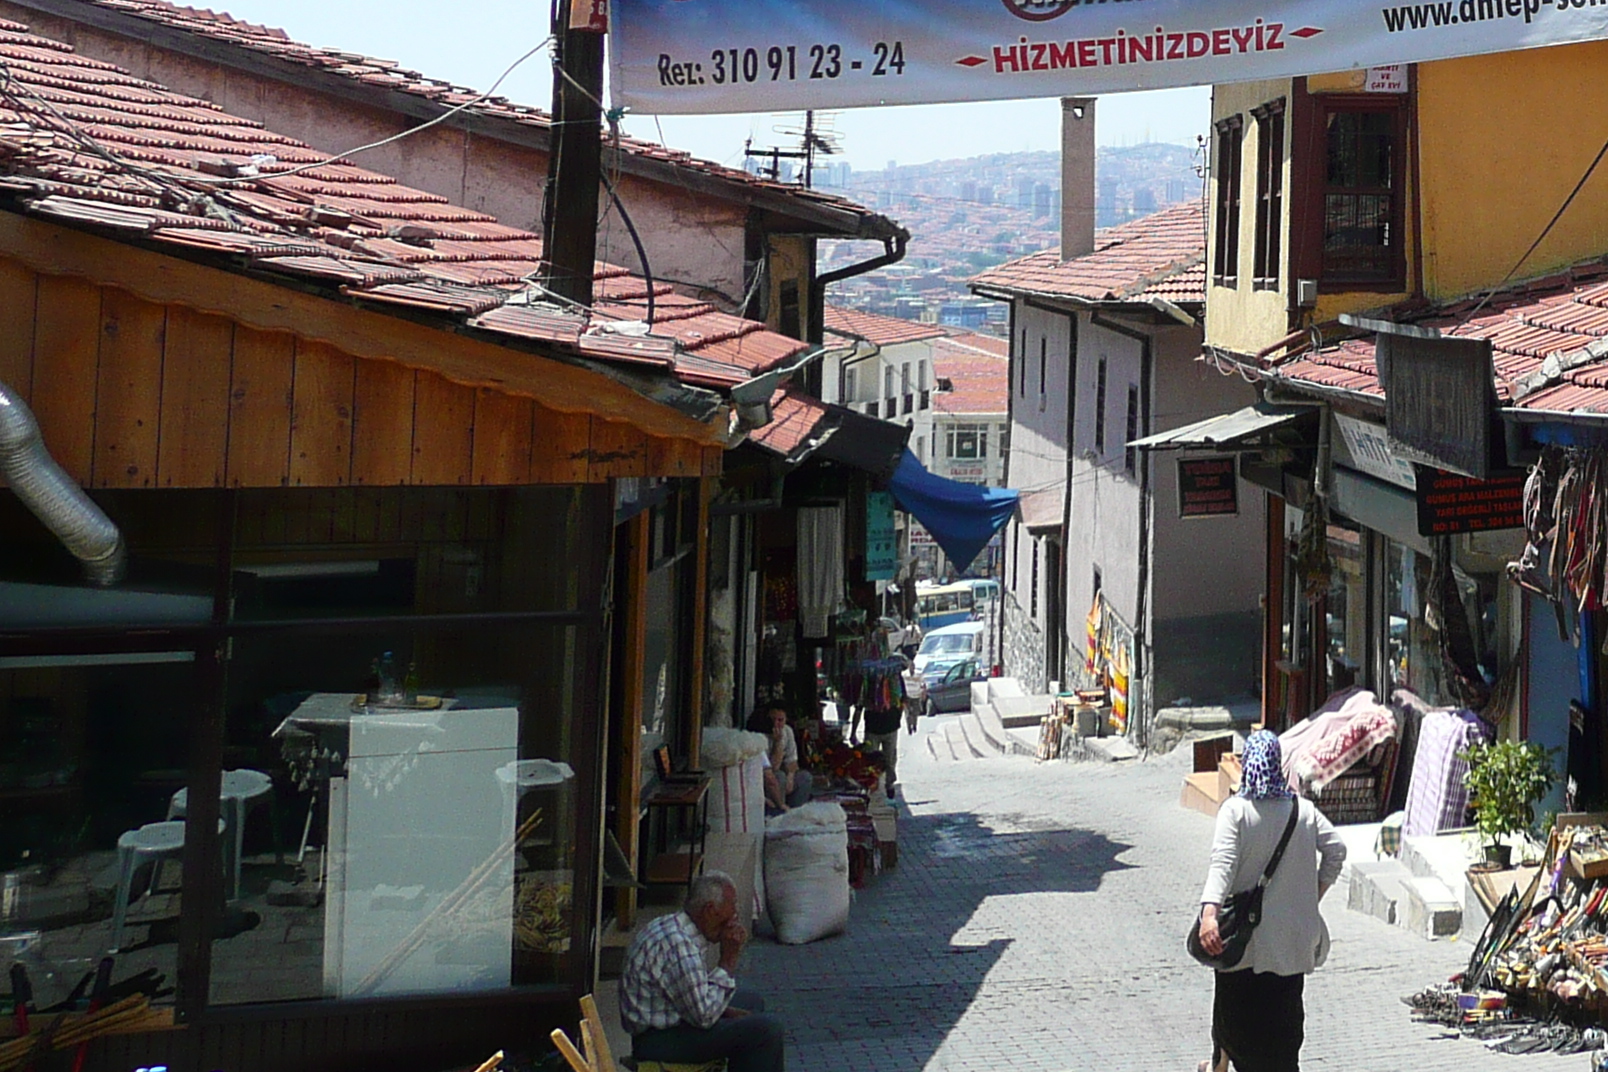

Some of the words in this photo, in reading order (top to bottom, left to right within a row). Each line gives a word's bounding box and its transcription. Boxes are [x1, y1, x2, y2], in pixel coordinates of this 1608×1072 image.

[657, 52, 705, 86] Rez:
[711, 45, 760, 84] 310
[766, 45, 797, 81] 91
[809, 44, 841, 81] 23
[872, 42, 905, 77] 24
[993, 18, 1285, 73] HİZMETİNİZDEYİZ
